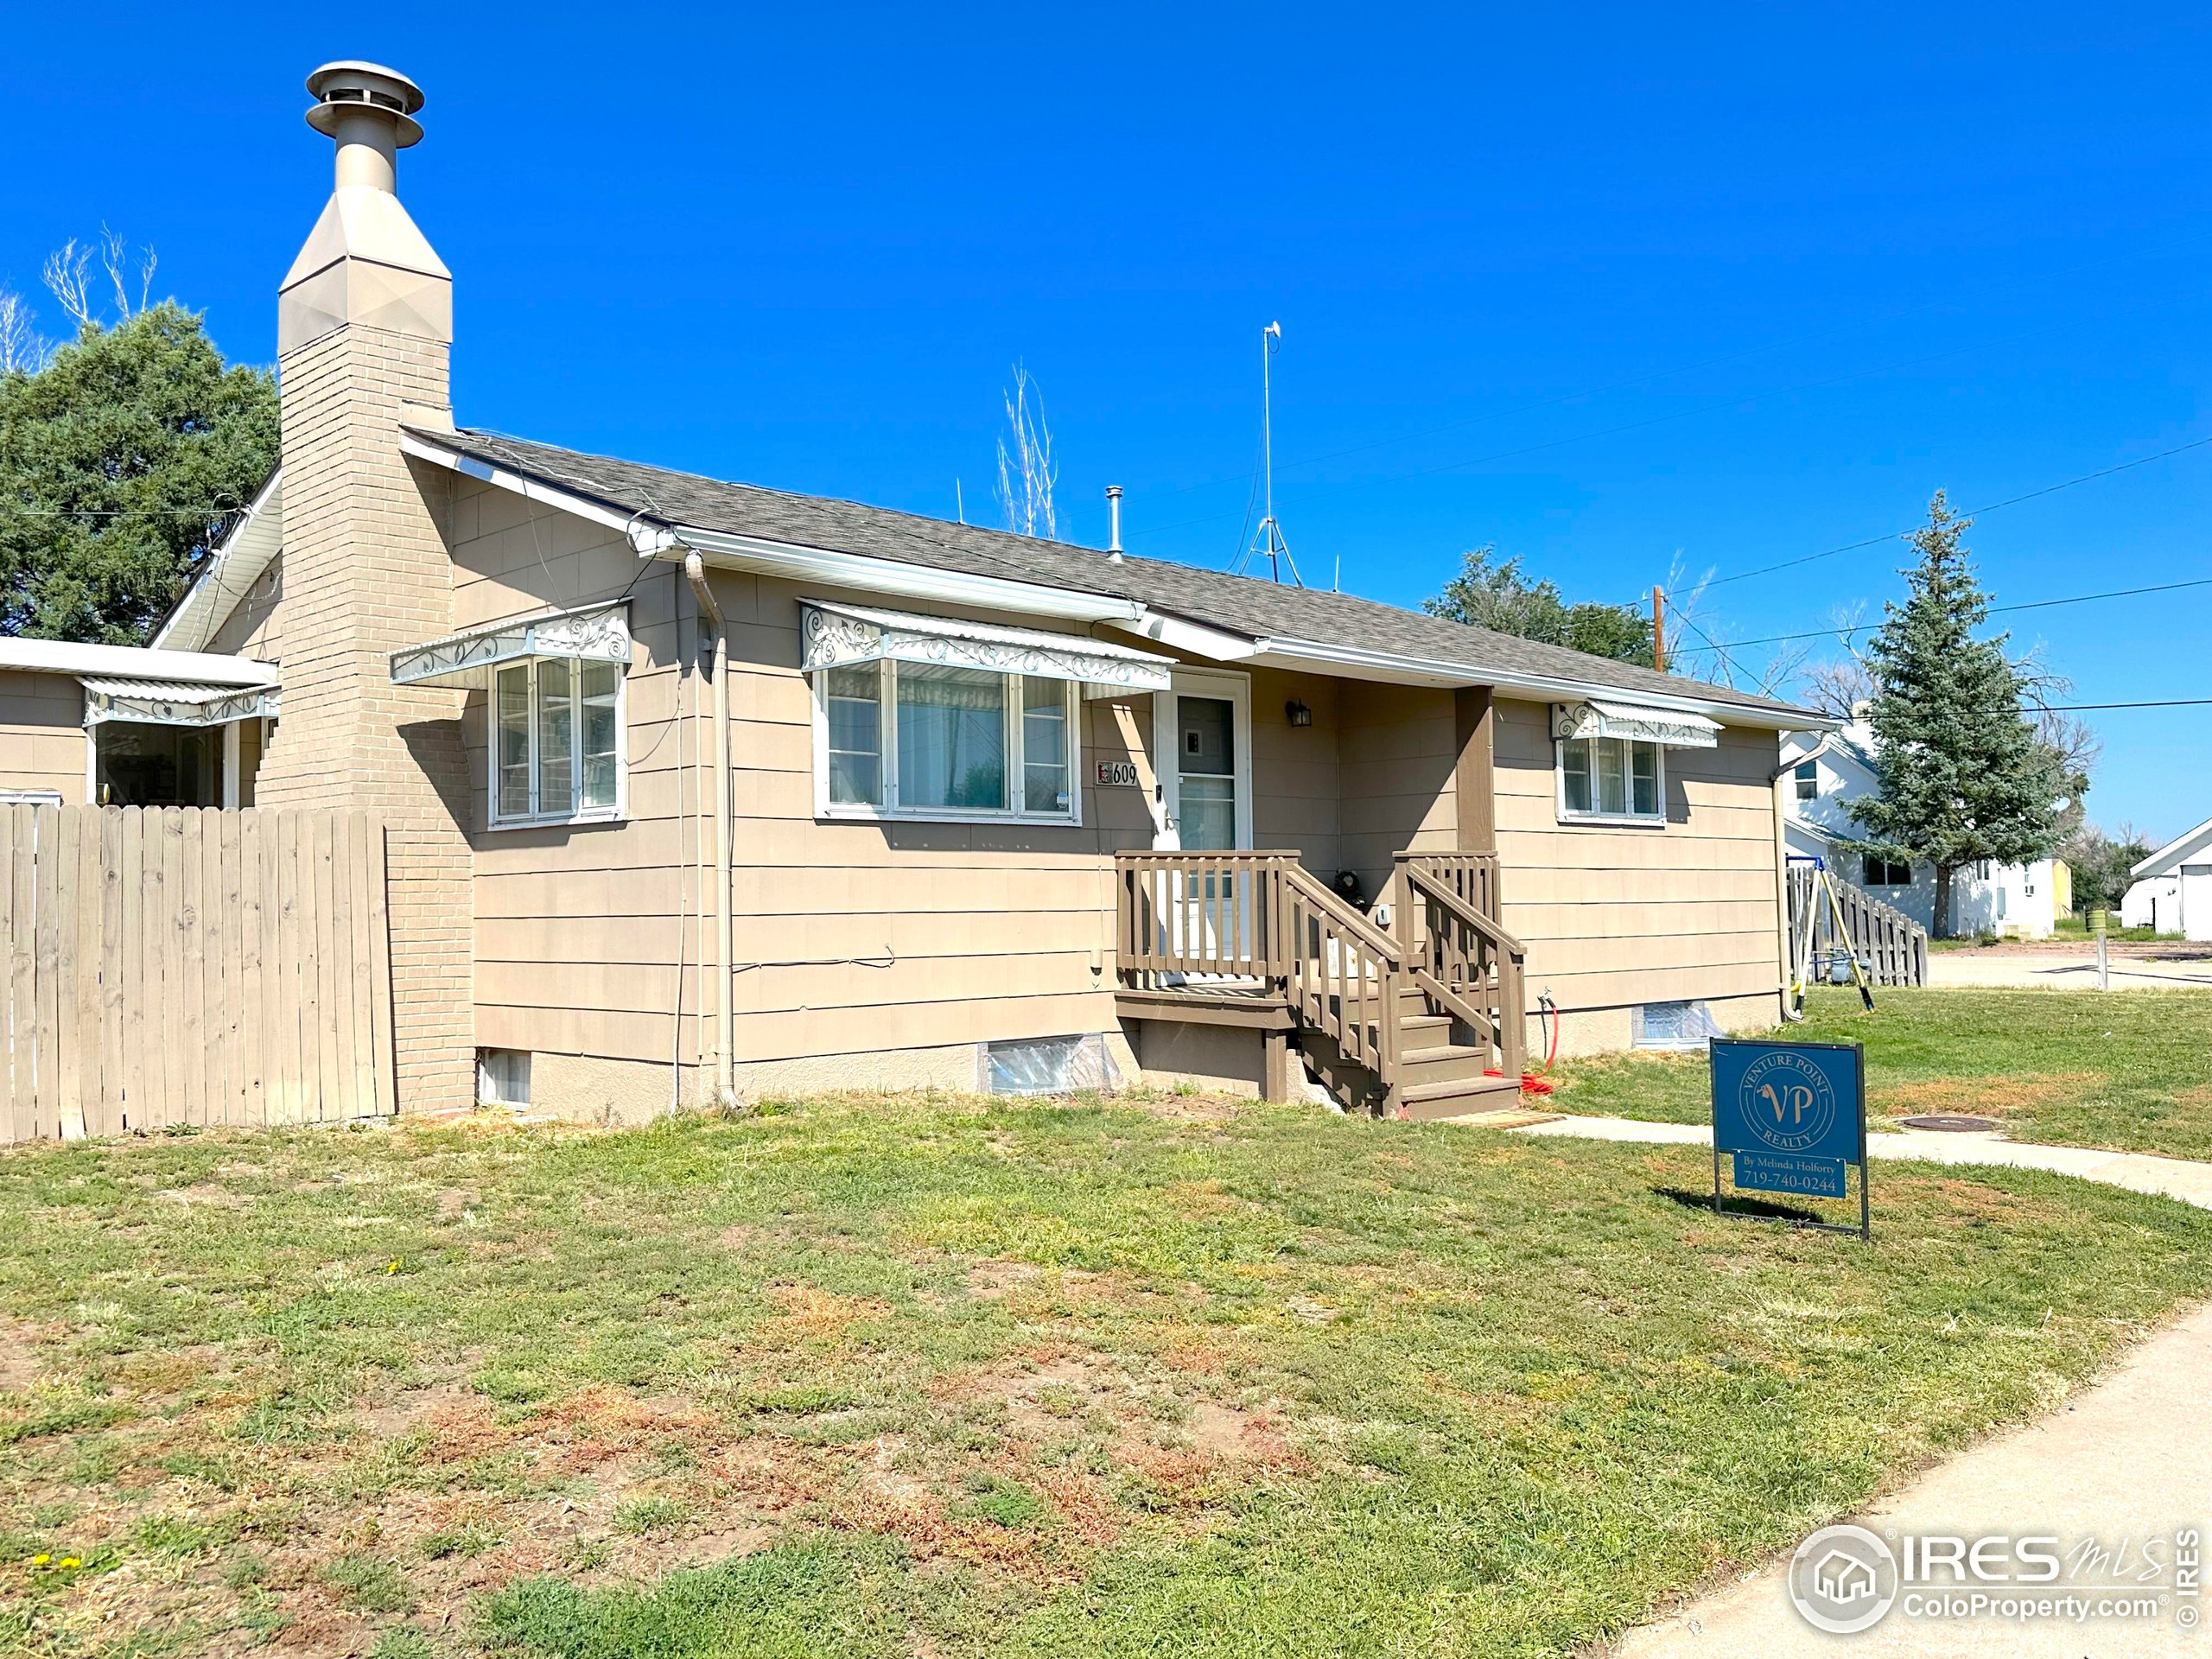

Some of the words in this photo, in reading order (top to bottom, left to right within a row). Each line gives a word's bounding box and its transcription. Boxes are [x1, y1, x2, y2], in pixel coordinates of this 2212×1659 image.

[1114, 764, 1136, 784] 609
[1744, 1055, 1793, 1089] VENTURE
[1796, 1058, 1829, 1094] POINT
[1764, 1084, 1813, 1124] VP
[1763, 1129, 1812, 1147] REALTY
[1744, 1155, 1755, 1167] By
[1758, 1157, 1794, 1170] Melinda
[1744, 1170, 1837, 1192] 719-740-0244
